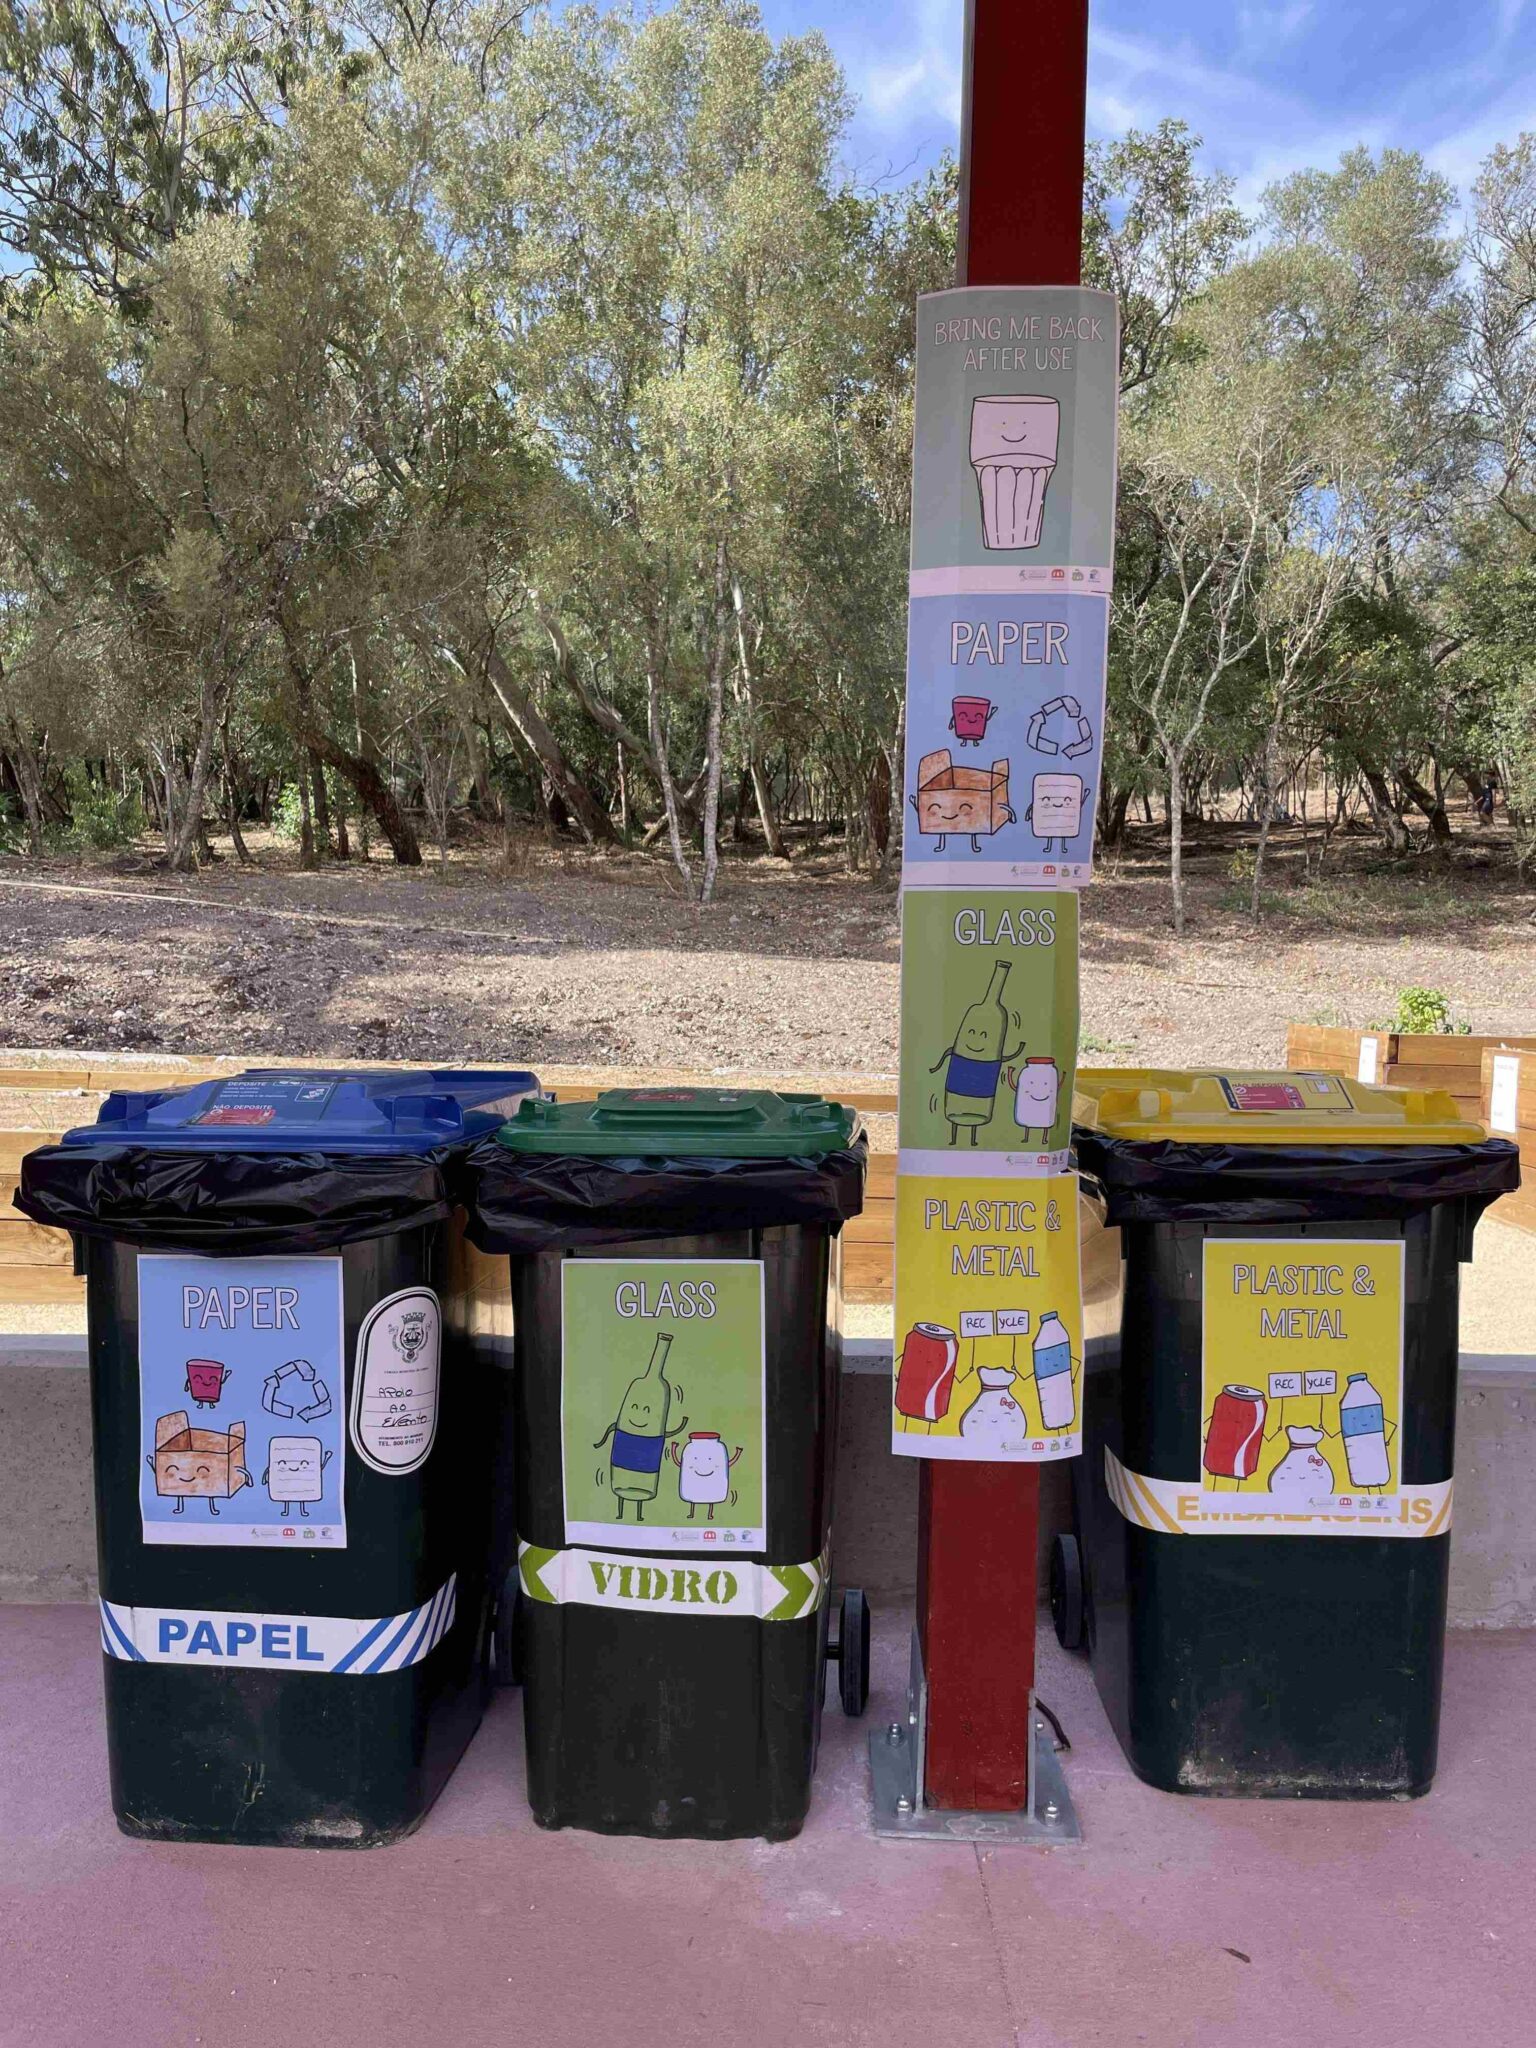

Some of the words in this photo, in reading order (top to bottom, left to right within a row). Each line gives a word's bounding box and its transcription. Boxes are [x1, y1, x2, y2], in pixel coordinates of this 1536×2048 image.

[934, 316, 1002, 345] BRING
[1007, 316, 1042, 341] ME
[1048, 316, 1105, 342] BACK
[962, 346, 1027, 371] AFTER
[1034, 346, 1074, 371] USE
[950, 621, 1070, 665] PAPER
[953, 908, 1057, 947] GLASS
[924, 1198, 1036, 1233] PLASTIC
[1044, 1199, 1062, 1232] &
[951, 1244, 1041, 1278] METAL
[1232, 1263, 1344, 1296] PLASTIC
[1352, 1264, 1376, 1296] &
[182, 1285, 300, 1330] PAPER
[614, 1280, 718, 1319] GLASS
[965, 1317, 986, 1329] REC
[998, 1316, 1026, 1329] YCLE
[1259, 1308, 1349, 1340] METAL
[1274, 1378, 1295, 1390] REC
[1306, 1376, 1333, 1390] YCLE
[587, 1560, 738, 1605] VIDRO
[157, 1617, 325, 1662] PAPEL
